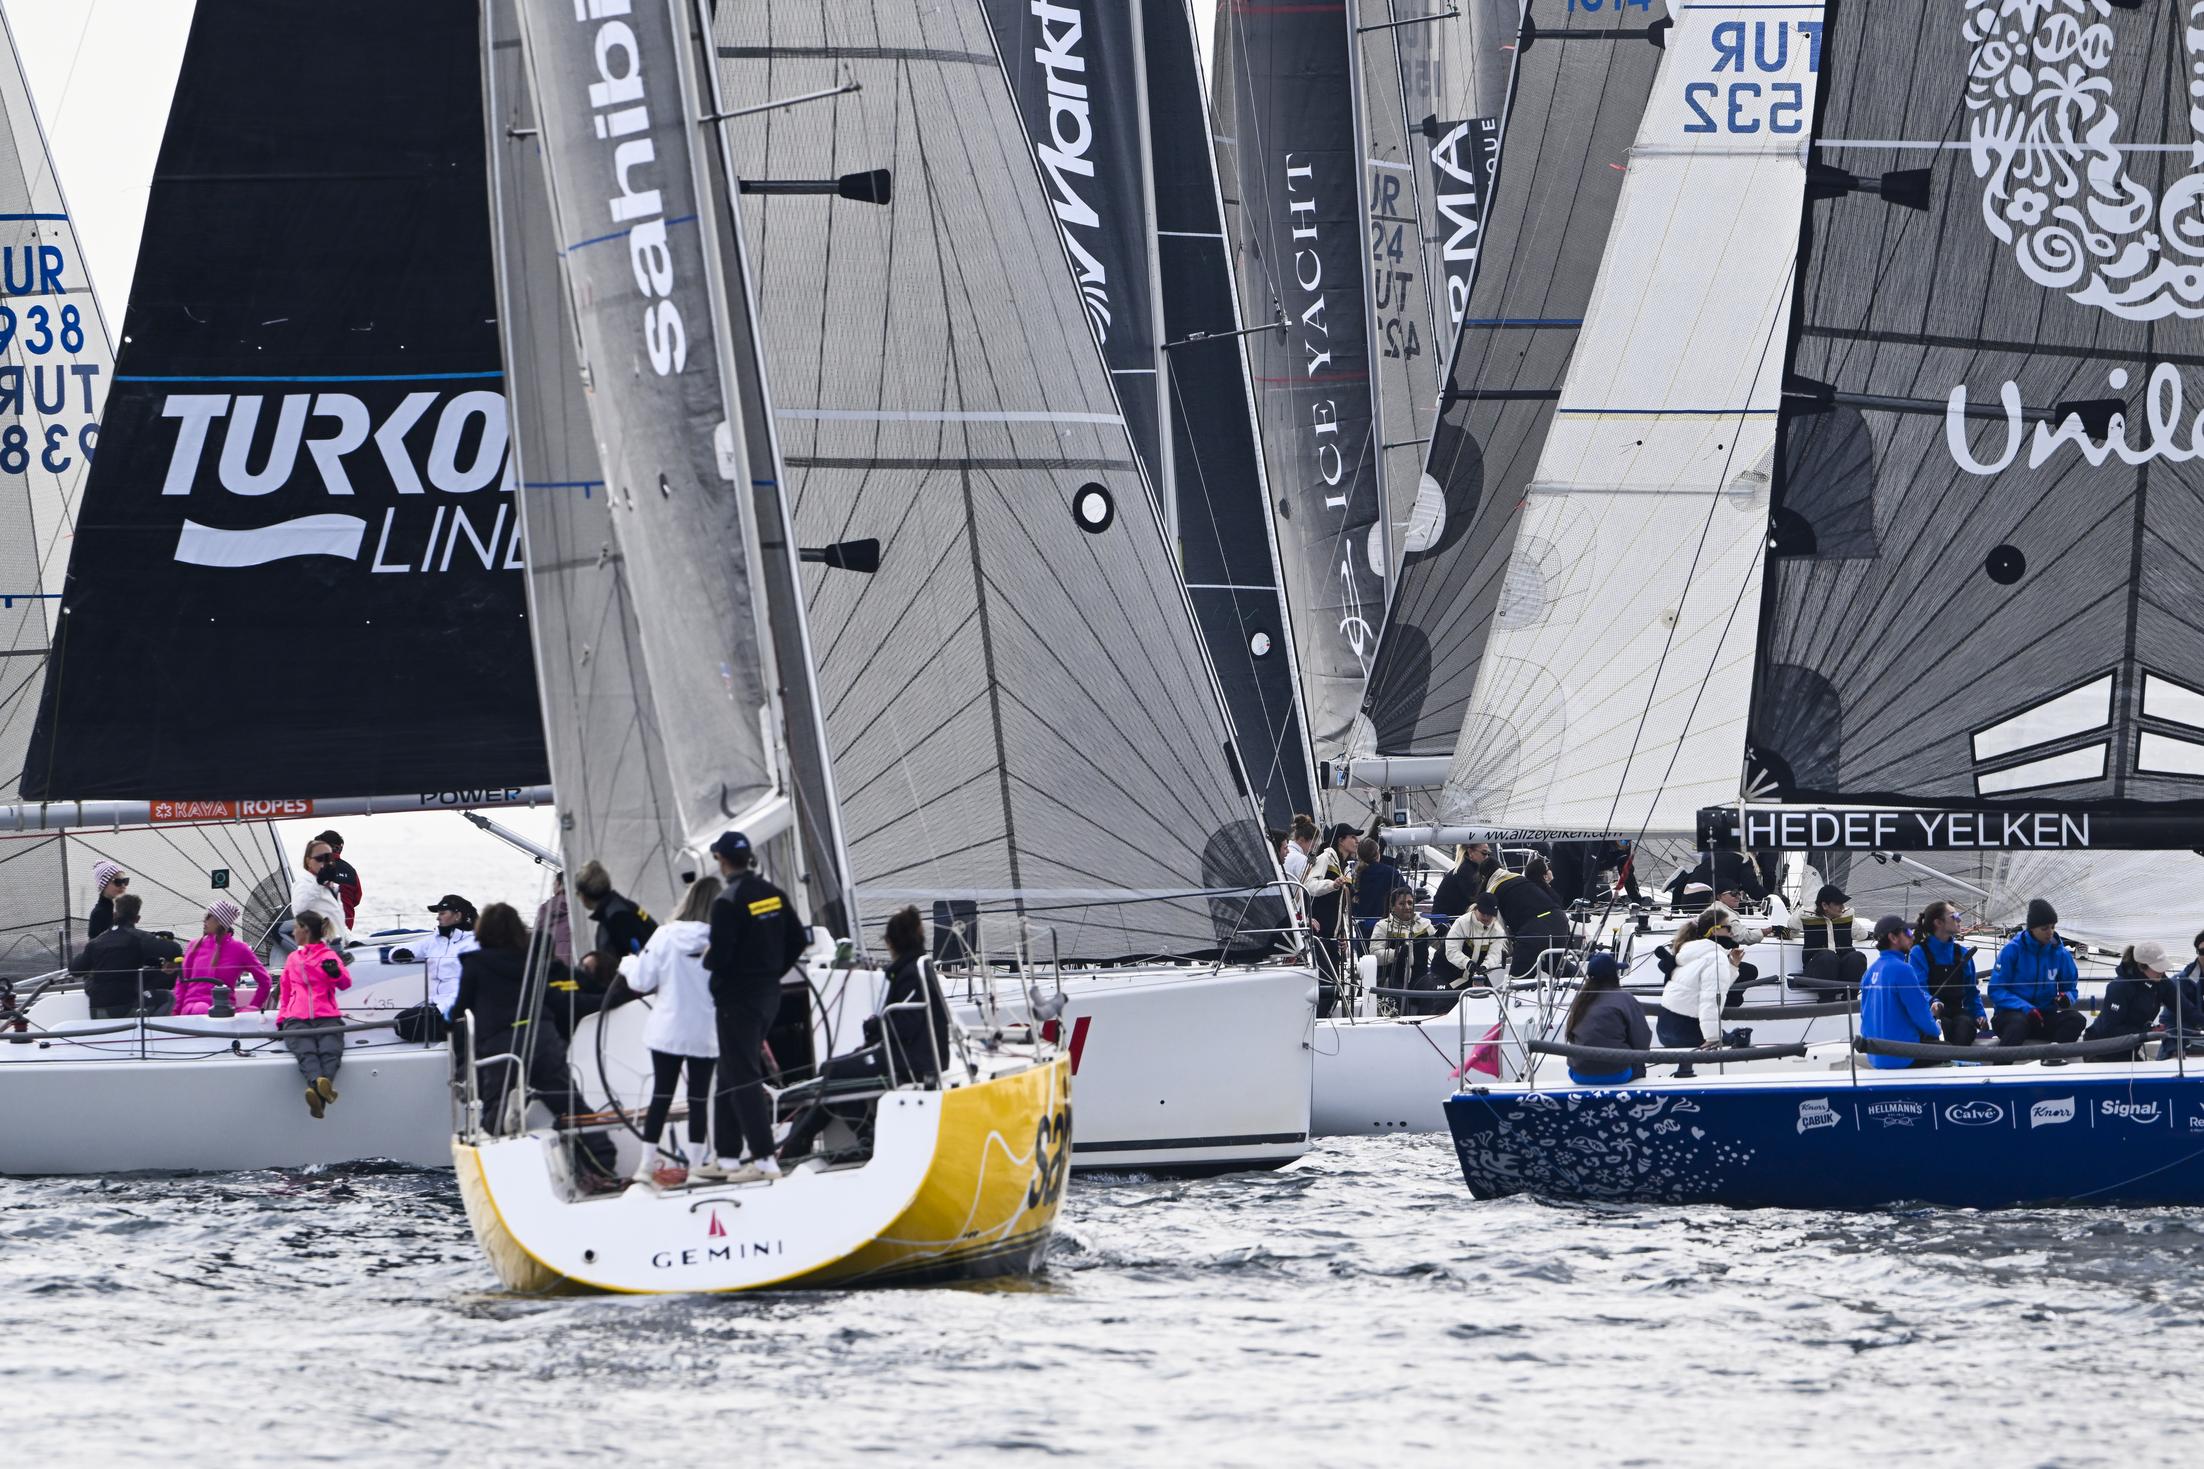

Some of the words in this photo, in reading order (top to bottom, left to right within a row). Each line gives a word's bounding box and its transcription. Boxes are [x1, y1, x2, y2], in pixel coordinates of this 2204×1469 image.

[1285, 152, 1331, 379] YACHT
[1946, 362, 2204, 476] Unil
[161, 391, 516, 496] TURKO
[1312, 399, 1348, 511] ICE
[175, 801, 228, 818] KAYA
[243, 799, 307, 815] ROPES
[1748, 813, 1899, 847] HEDEF
[1914, 813, 2090, 847] YELKEN
[1952, 1107, 1994, 1119] Calvé
[2032, 1106, 2073, 1117] Knorr
[2101, 1100, 2158, 1117] Signal
[652, 1240, 783, 1268] GEMINI
